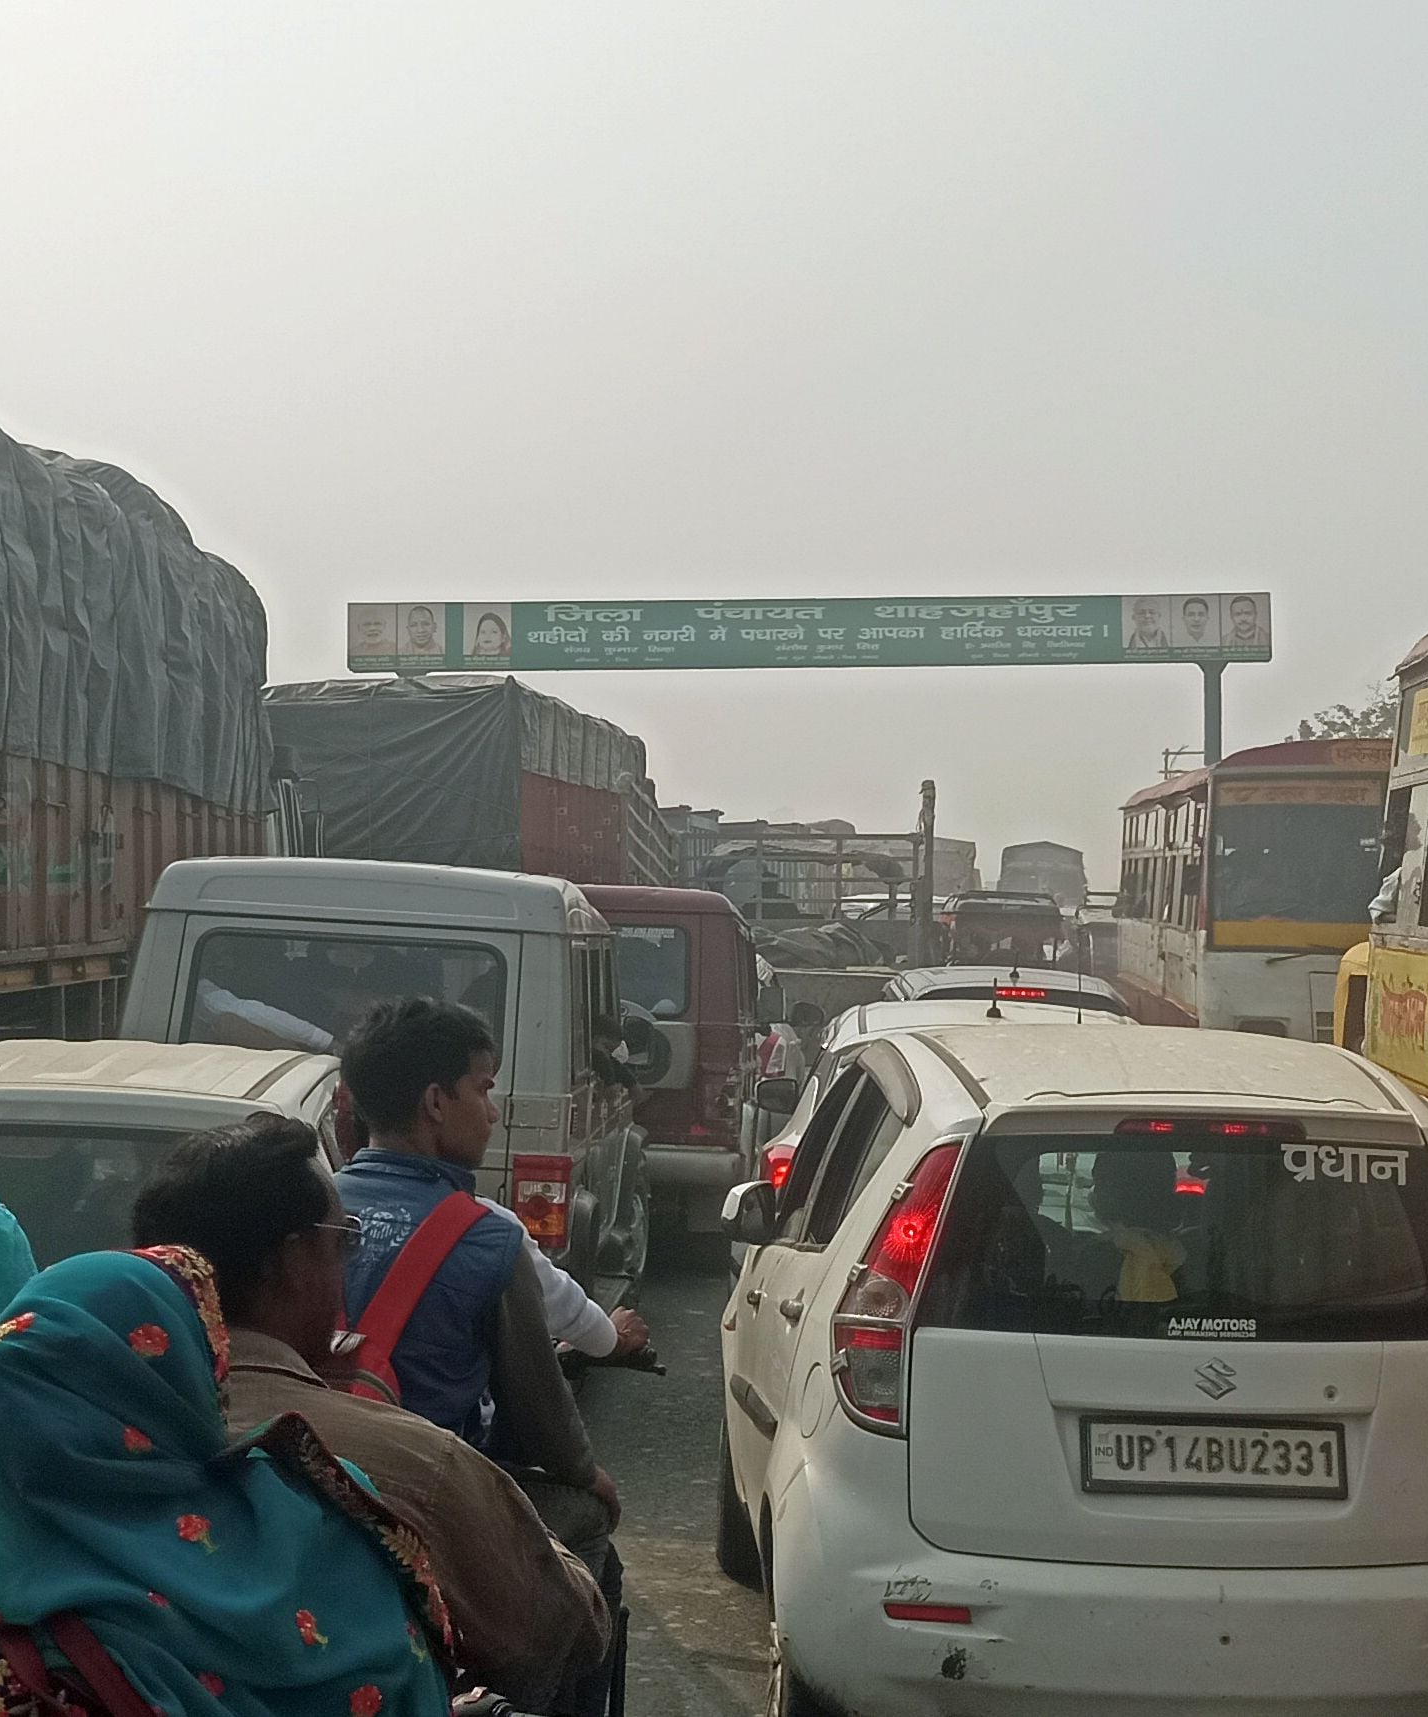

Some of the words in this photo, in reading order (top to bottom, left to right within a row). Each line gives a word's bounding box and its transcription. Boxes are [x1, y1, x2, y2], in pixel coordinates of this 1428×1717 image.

[544, 603, 644, 622] जिला
[695, 601, 826, 621] पंचायत
[874, 597, 1081, 623] शाहजहाँपुर
[527, 626, 589, 644] शहीदों
[601, 625, 631, 642] की
[643, 624, 696, 642] नगरी
[709, 624, 728, 641] में
[741, 623, 805, 641] पधारने
[818, 627, 846, 640] पर
[858, 626, 925, 640] आपका
[940, 620, 1005, 640] हार्दिक
[1016, 624, 1093, 638] धन्यवाद
[1280, 1143, 1409, 1186] प्रधान
[1168, 1316, 1200, 1330] AJAY
[1201, 1318, 1257, 1331] MOTORS
[1094, 1446, 1114, 1457] IND
[1115, 1434, 1334, 1478] UP14BU2331
